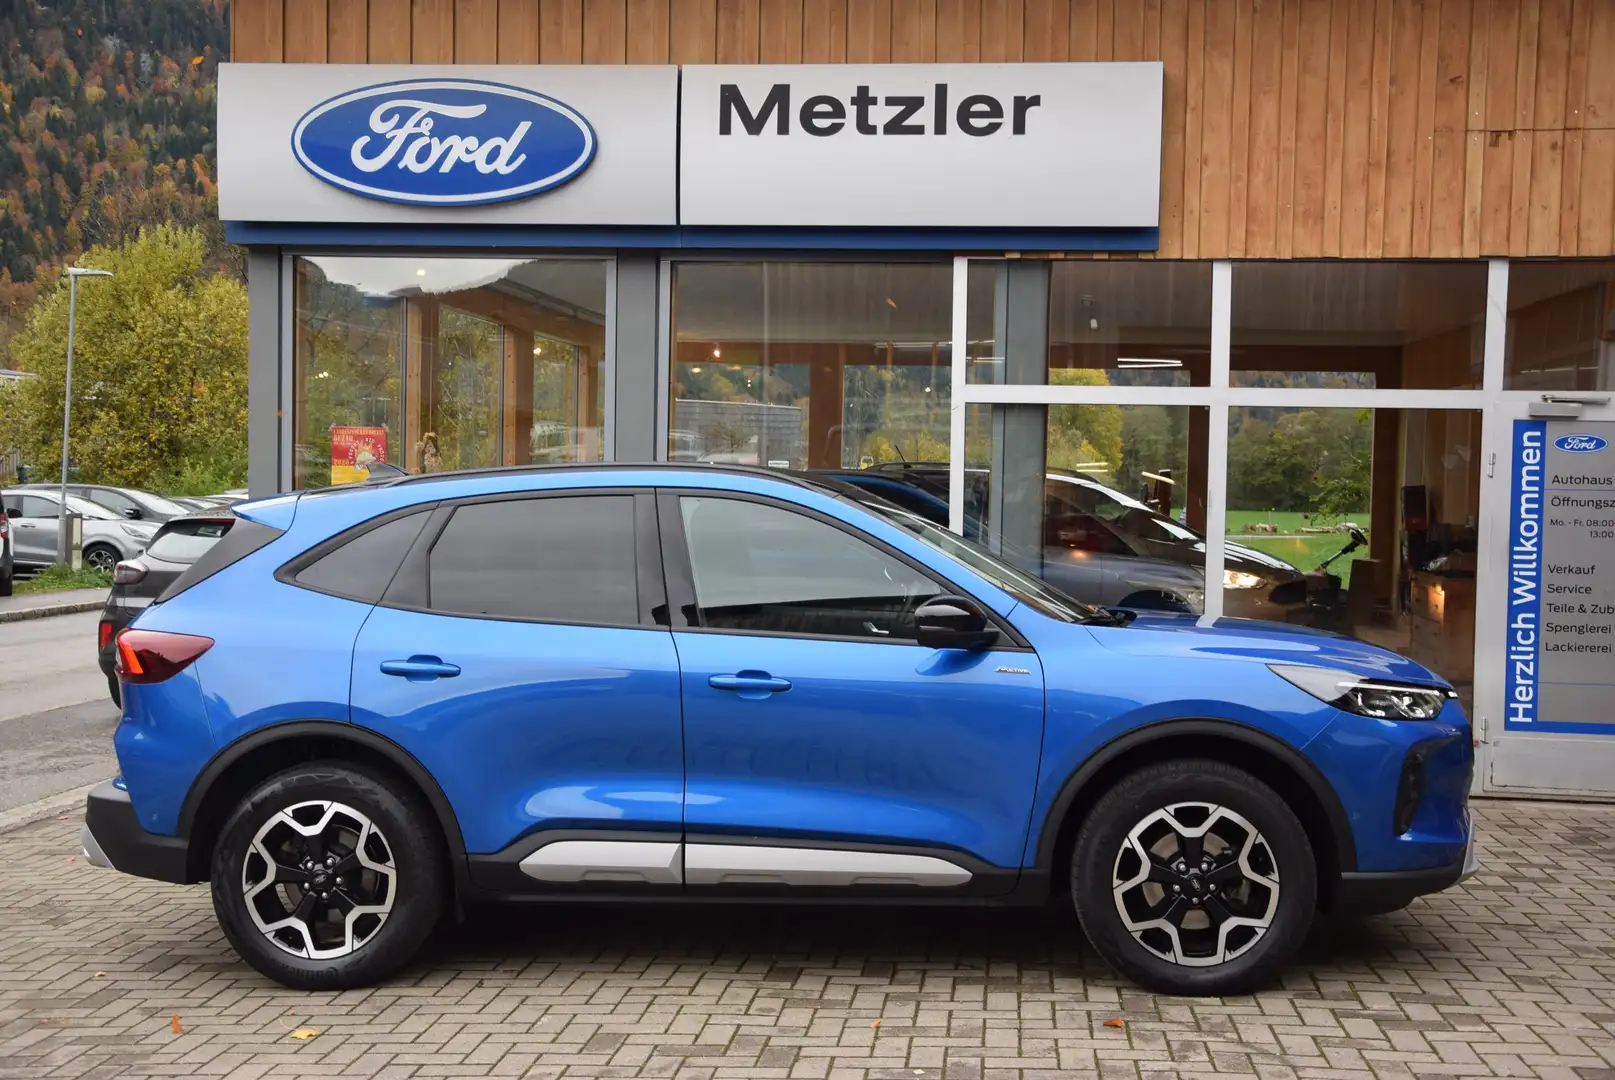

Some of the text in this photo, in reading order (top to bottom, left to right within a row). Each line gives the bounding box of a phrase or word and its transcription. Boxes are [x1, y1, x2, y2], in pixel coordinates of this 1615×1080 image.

[719, 83, 1041, 137] Metzler
[350, 99, 532, 175] Ford
[1564, 436, 1597, 450] Ford
[1551, 474, 1613, 485] Autohaus
[1551, 495, 1615, 509] Öffnungsz
[1573, 519, 1584, 527] Fr.
[1586, 519, 1615, 527] 08:00
[1589, 530, 1614, 538] 13:00
[1548, 564, 1596, 575] Verkauf
[1509, 431, 1541, 723] Herzlich Willkommen
[1547, 583, 1592, 594] Service
[1546, 603, 1615, 614] Teile & Zub
[1546, 622, 1612, 635] Spenglerei
[1545, 642, 1612, 653] Lackiererei
